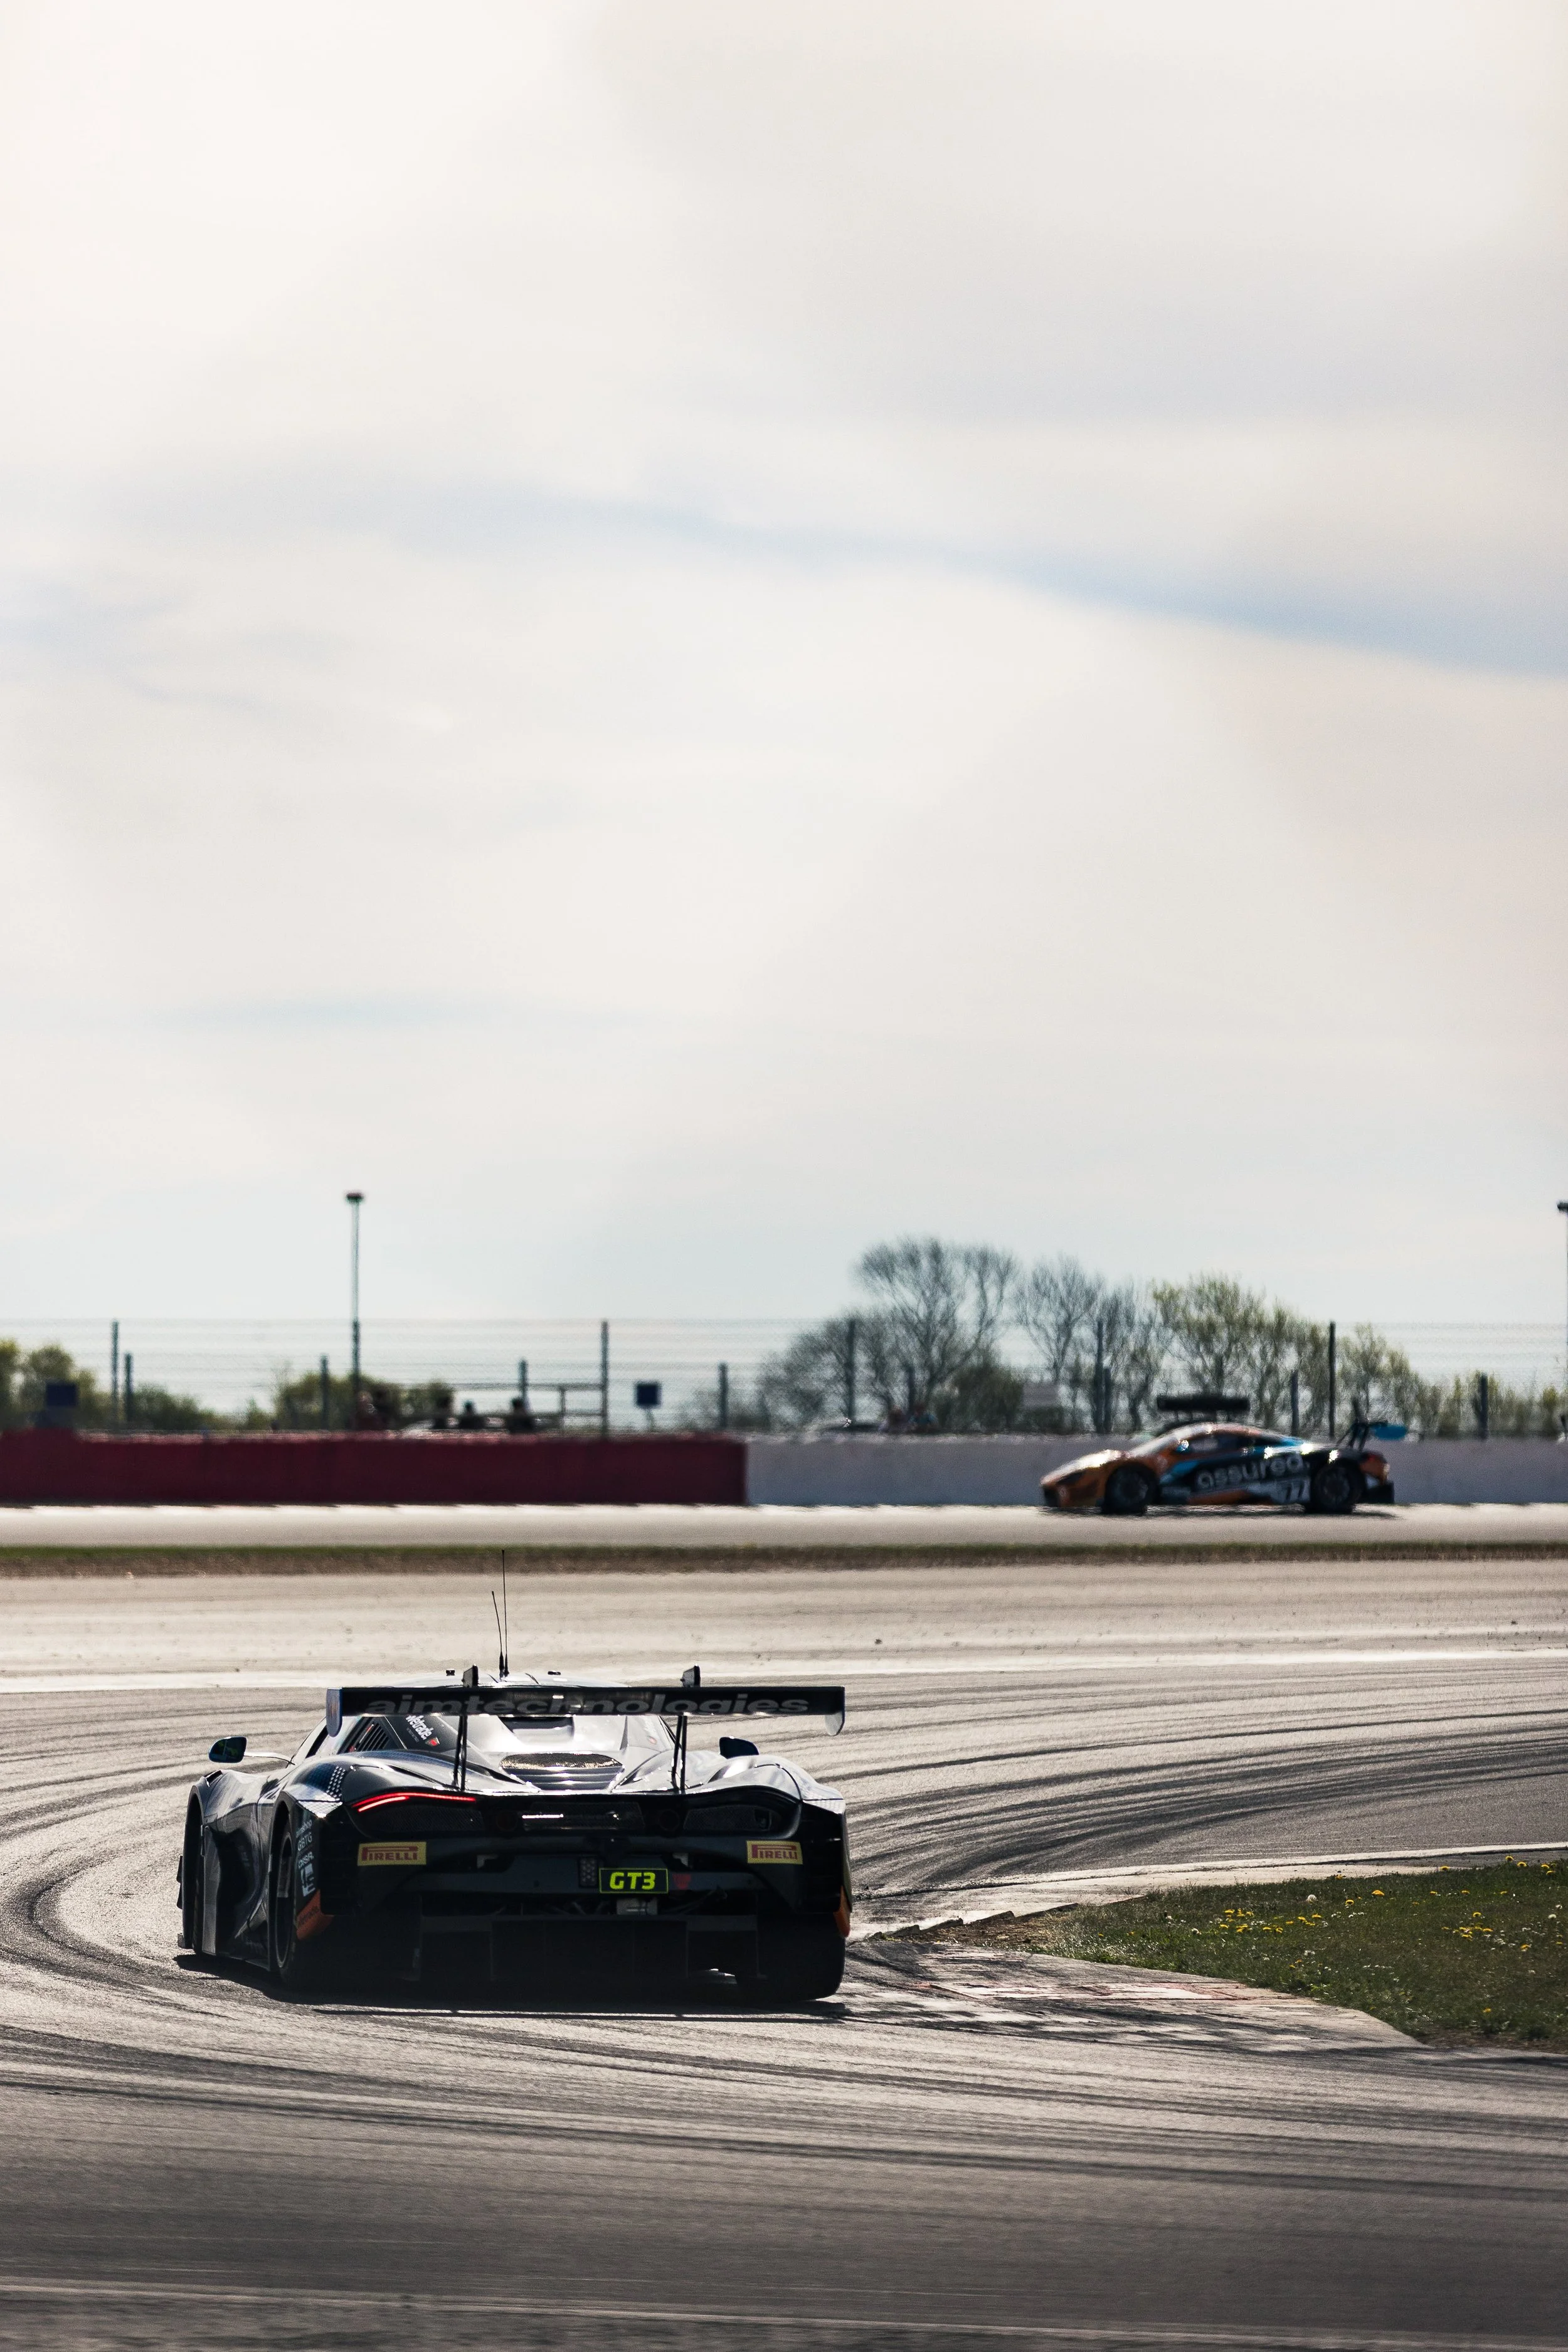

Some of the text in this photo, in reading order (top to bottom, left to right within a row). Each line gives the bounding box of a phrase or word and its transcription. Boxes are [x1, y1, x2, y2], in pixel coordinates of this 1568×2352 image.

[362, 1846, 418, 1861] PIRELLI
[752, 1845, 798, 1860] PIRELLI
[610, 1872, 656, 1890] GT3
